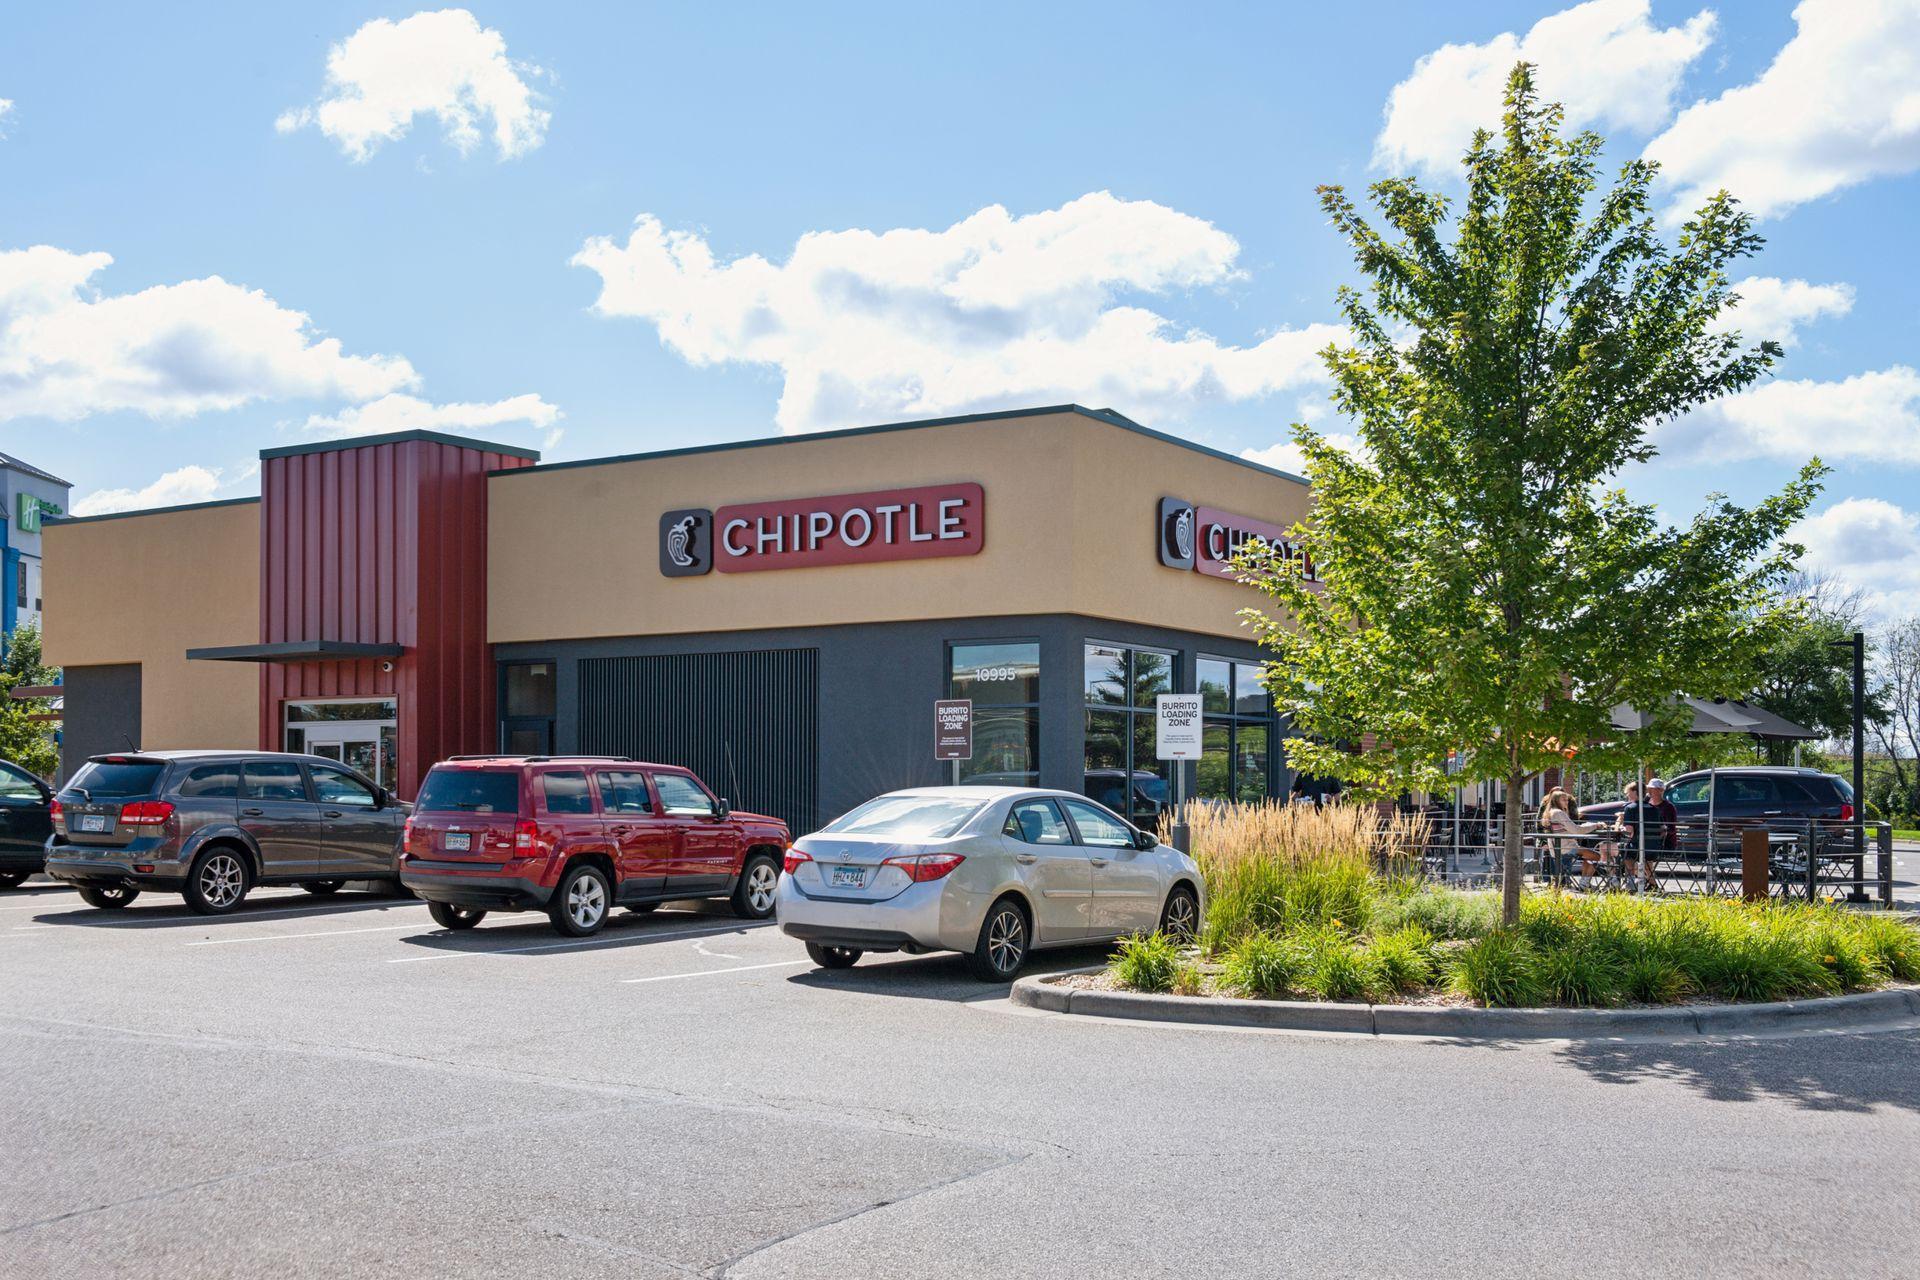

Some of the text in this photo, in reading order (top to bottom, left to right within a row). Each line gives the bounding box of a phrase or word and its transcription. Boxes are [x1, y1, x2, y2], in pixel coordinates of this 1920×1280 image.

[722, 498, 965, 557] CHIPOTLE
[975, 667, 1016, 682] 10995
[1161, 702, 1198, 710] BURRITO
[938, 706, 968, 715] BURRITO
[938, 714, 968, 722] LOADING
[944, 722, 963, 730] ZONE
[1168, 719, 1191, 727] ZONE
